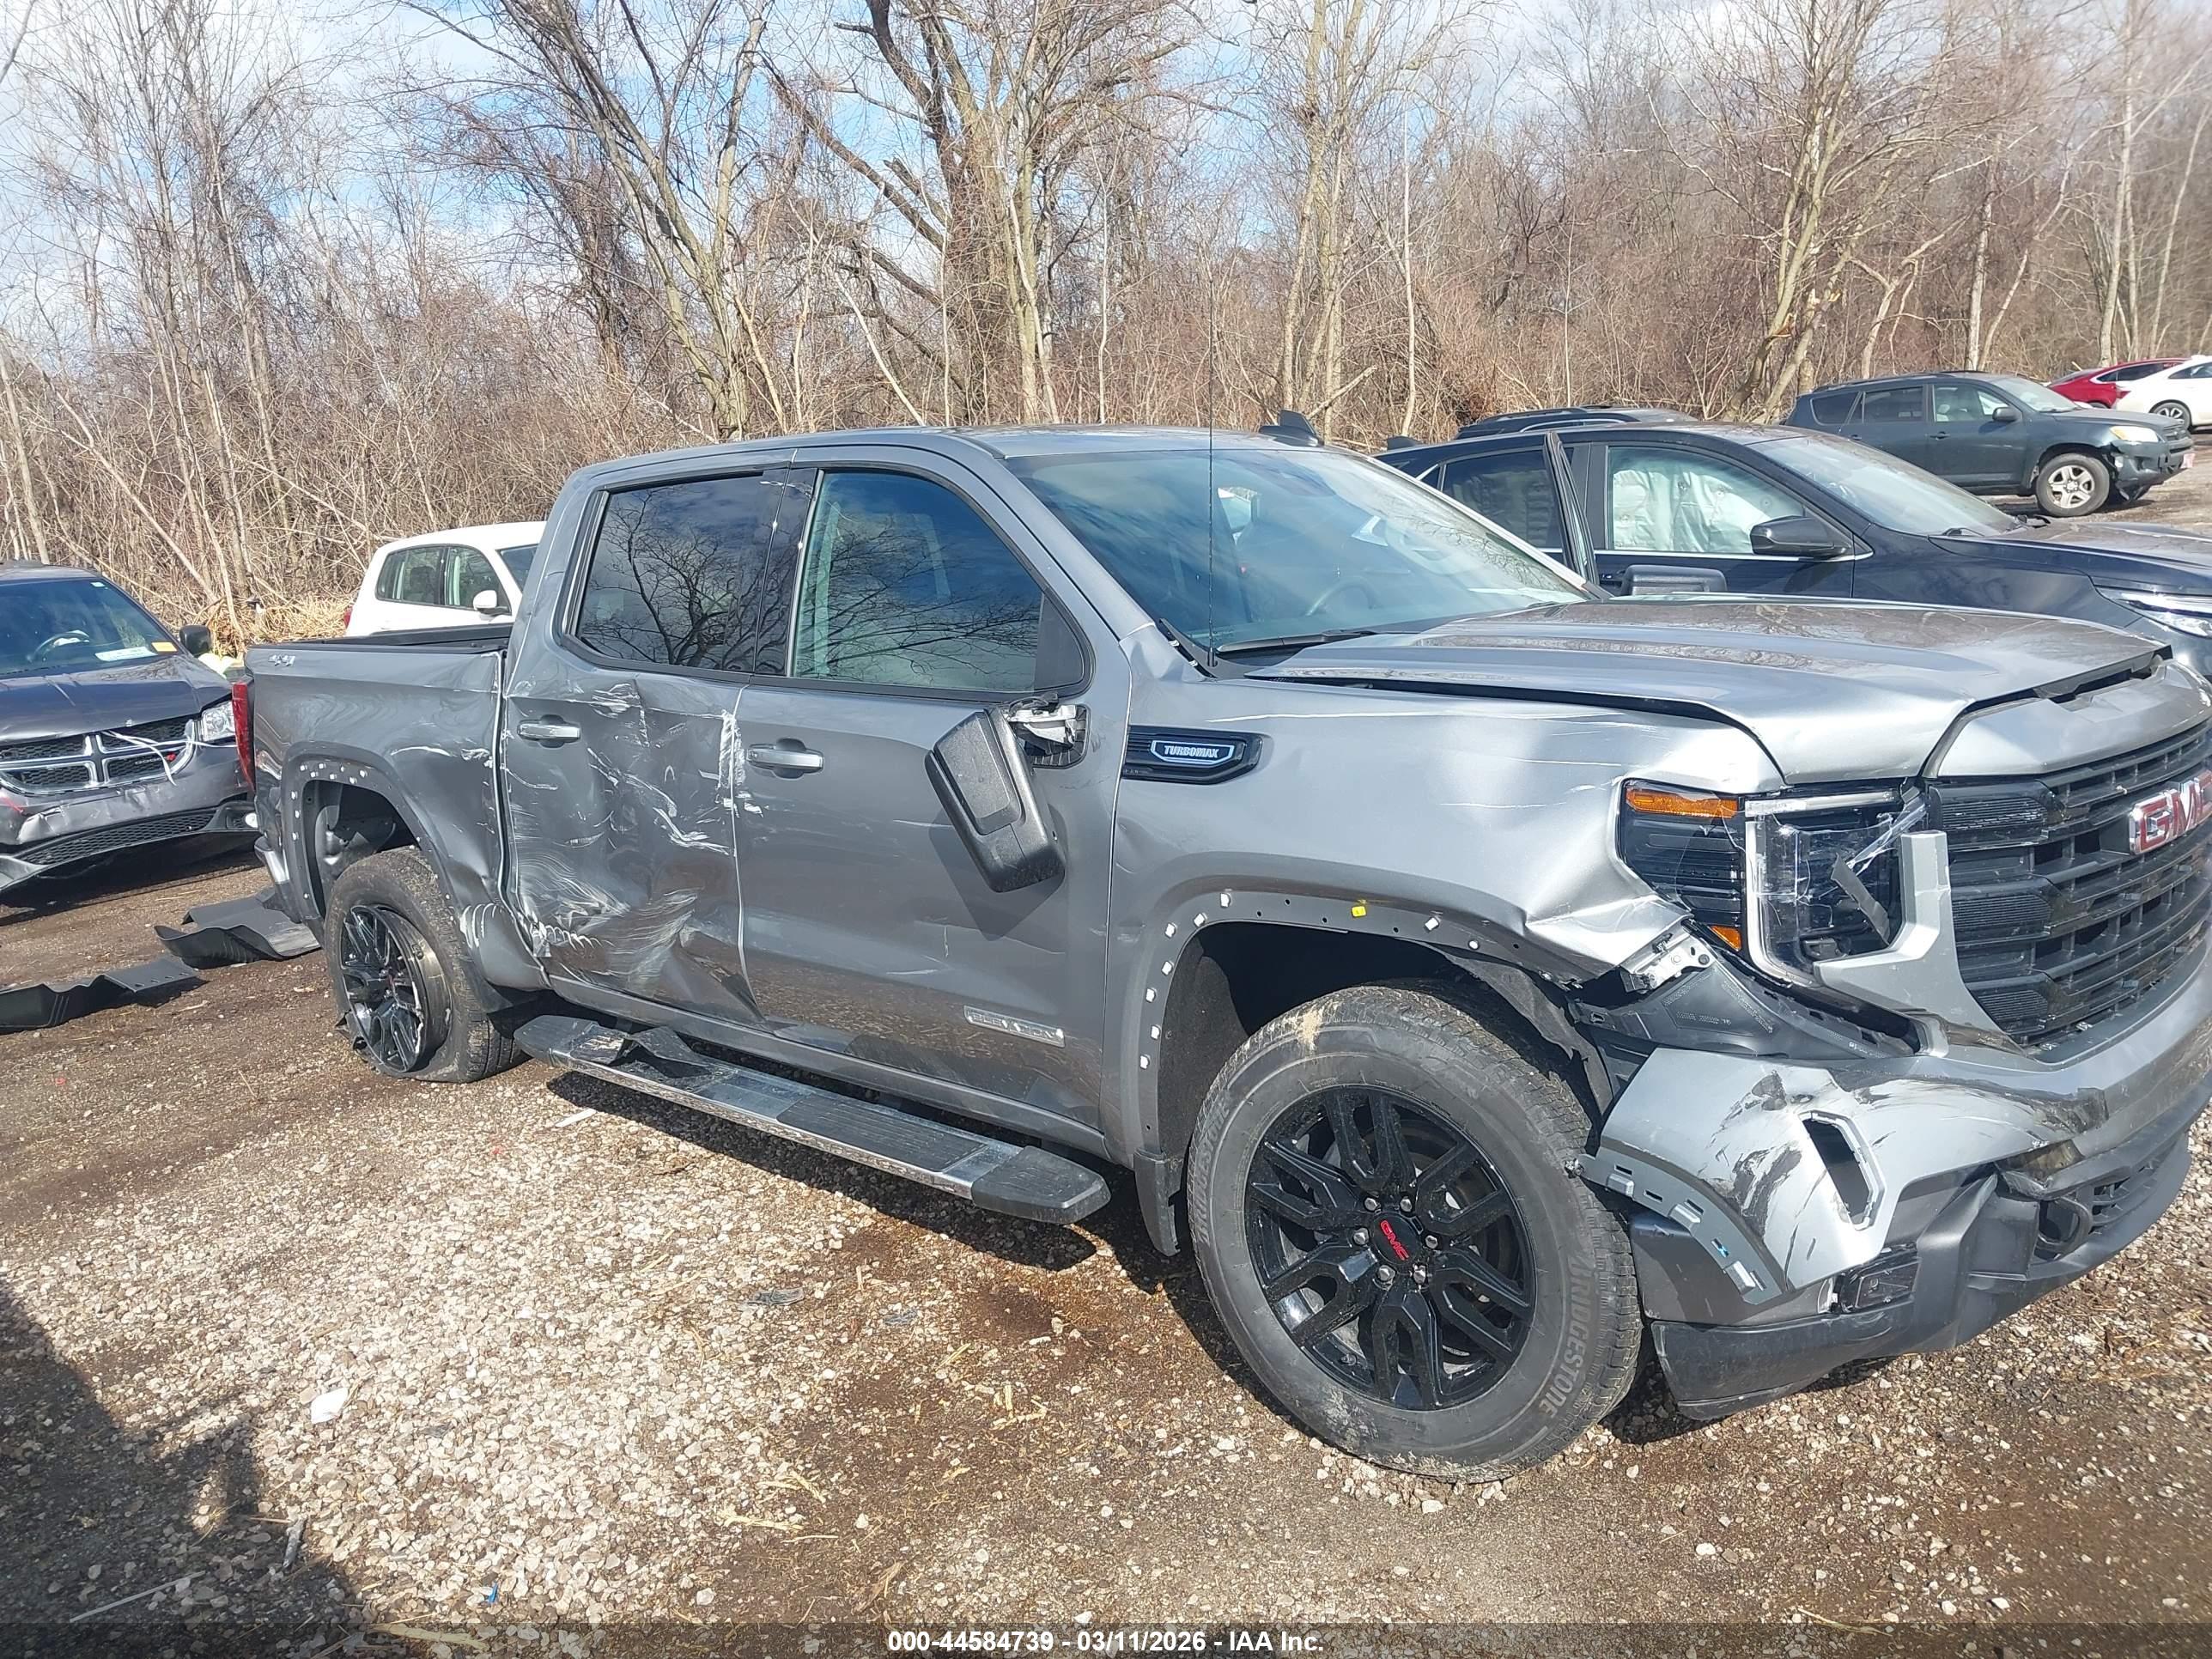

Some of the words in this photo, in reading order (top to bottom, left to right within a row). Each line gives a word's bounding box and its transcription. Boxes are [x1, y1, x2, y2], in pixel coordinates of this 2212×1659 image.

[1164, 744, 1219, 758] TURBOMAX
[1380, 1219, 1410, 1261] GMC
[1539, 1254, 1593, 1418] BRIDGESTONE
